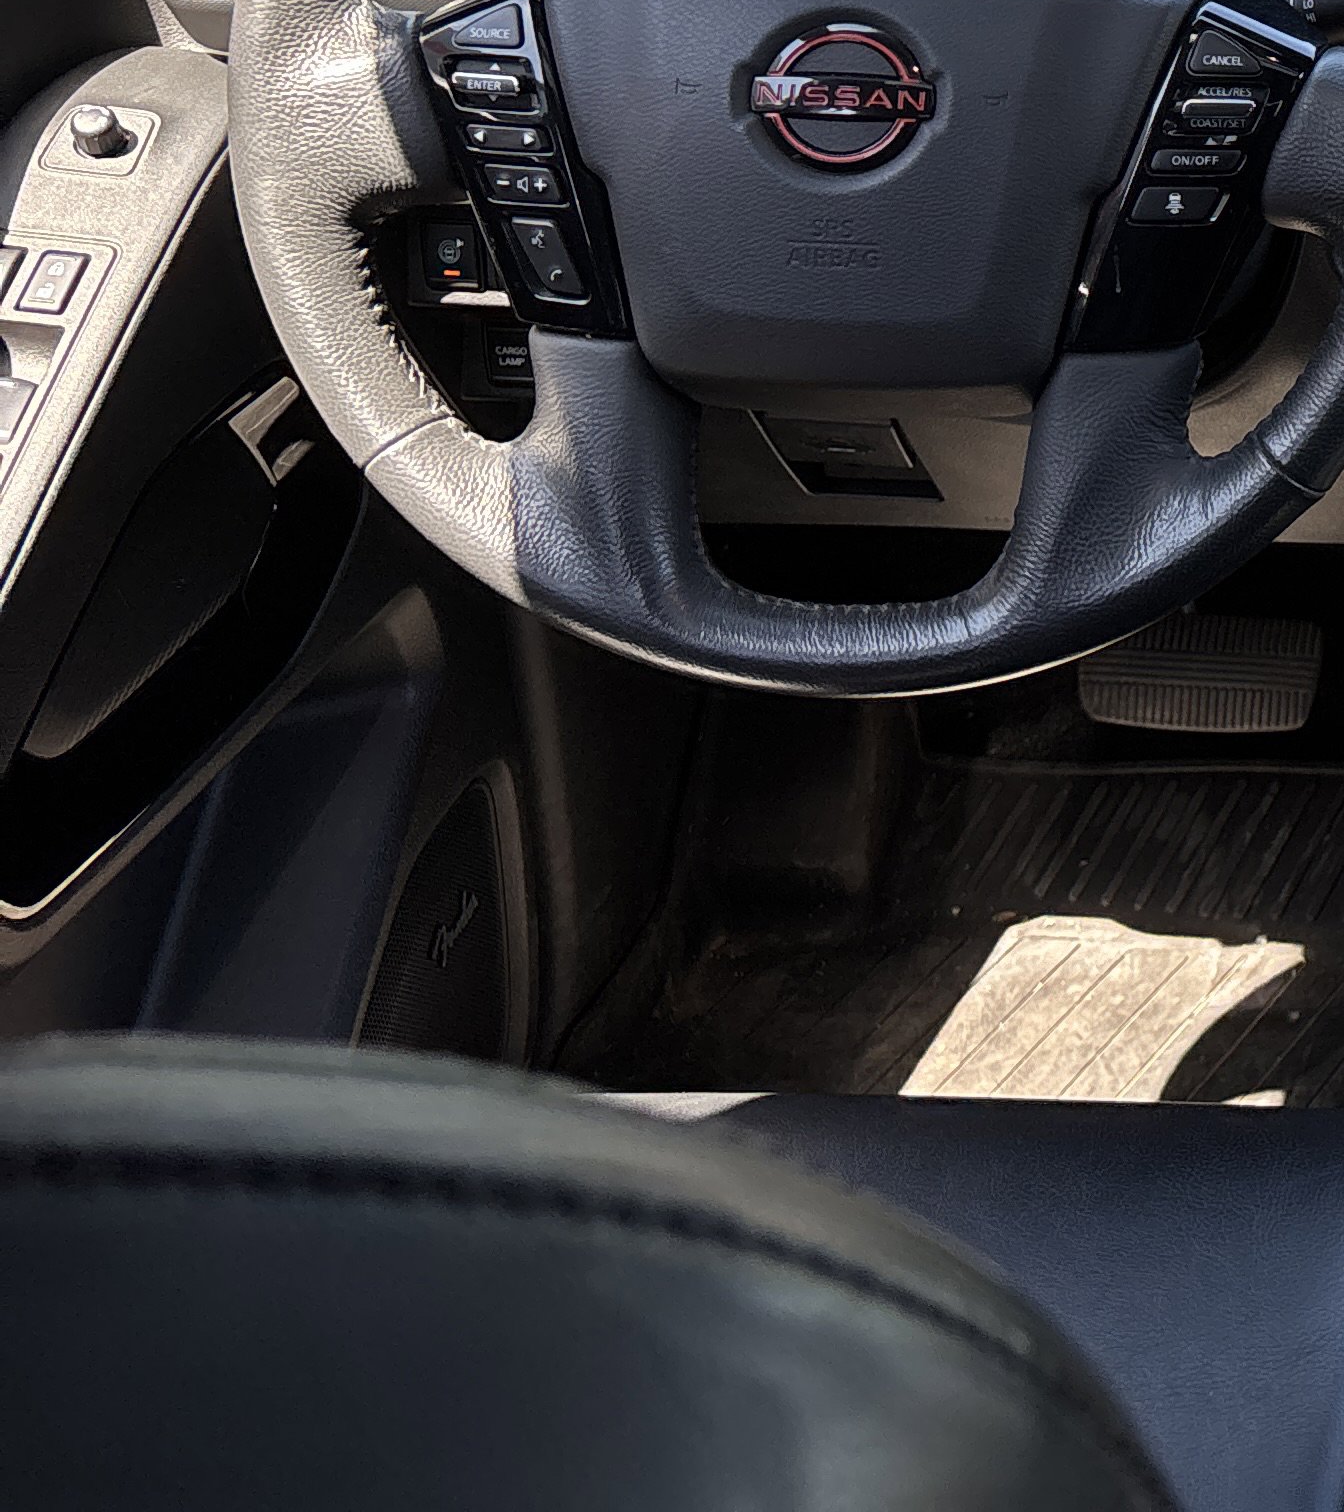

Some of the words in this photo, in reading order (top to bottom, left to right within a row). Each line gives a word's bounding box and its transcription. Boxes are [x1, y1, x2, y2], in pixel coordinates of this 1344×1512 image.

[469, 27, 511, 40] SOURCE
[1202, 55, 1244, 66] CANCEL
[467, 78, 502, 91] ENTER
[1198, 86, 1252, 97] ACCEL/RES
[756, 83, 927, 112] NISSAN
[1190, 118, 1247, 129] COAST/SET
[1171, 155, 1220, 166] ON/OFF
[495, 345, 528, 356] CARGO
[498, 356, 526, 366] LAMP
